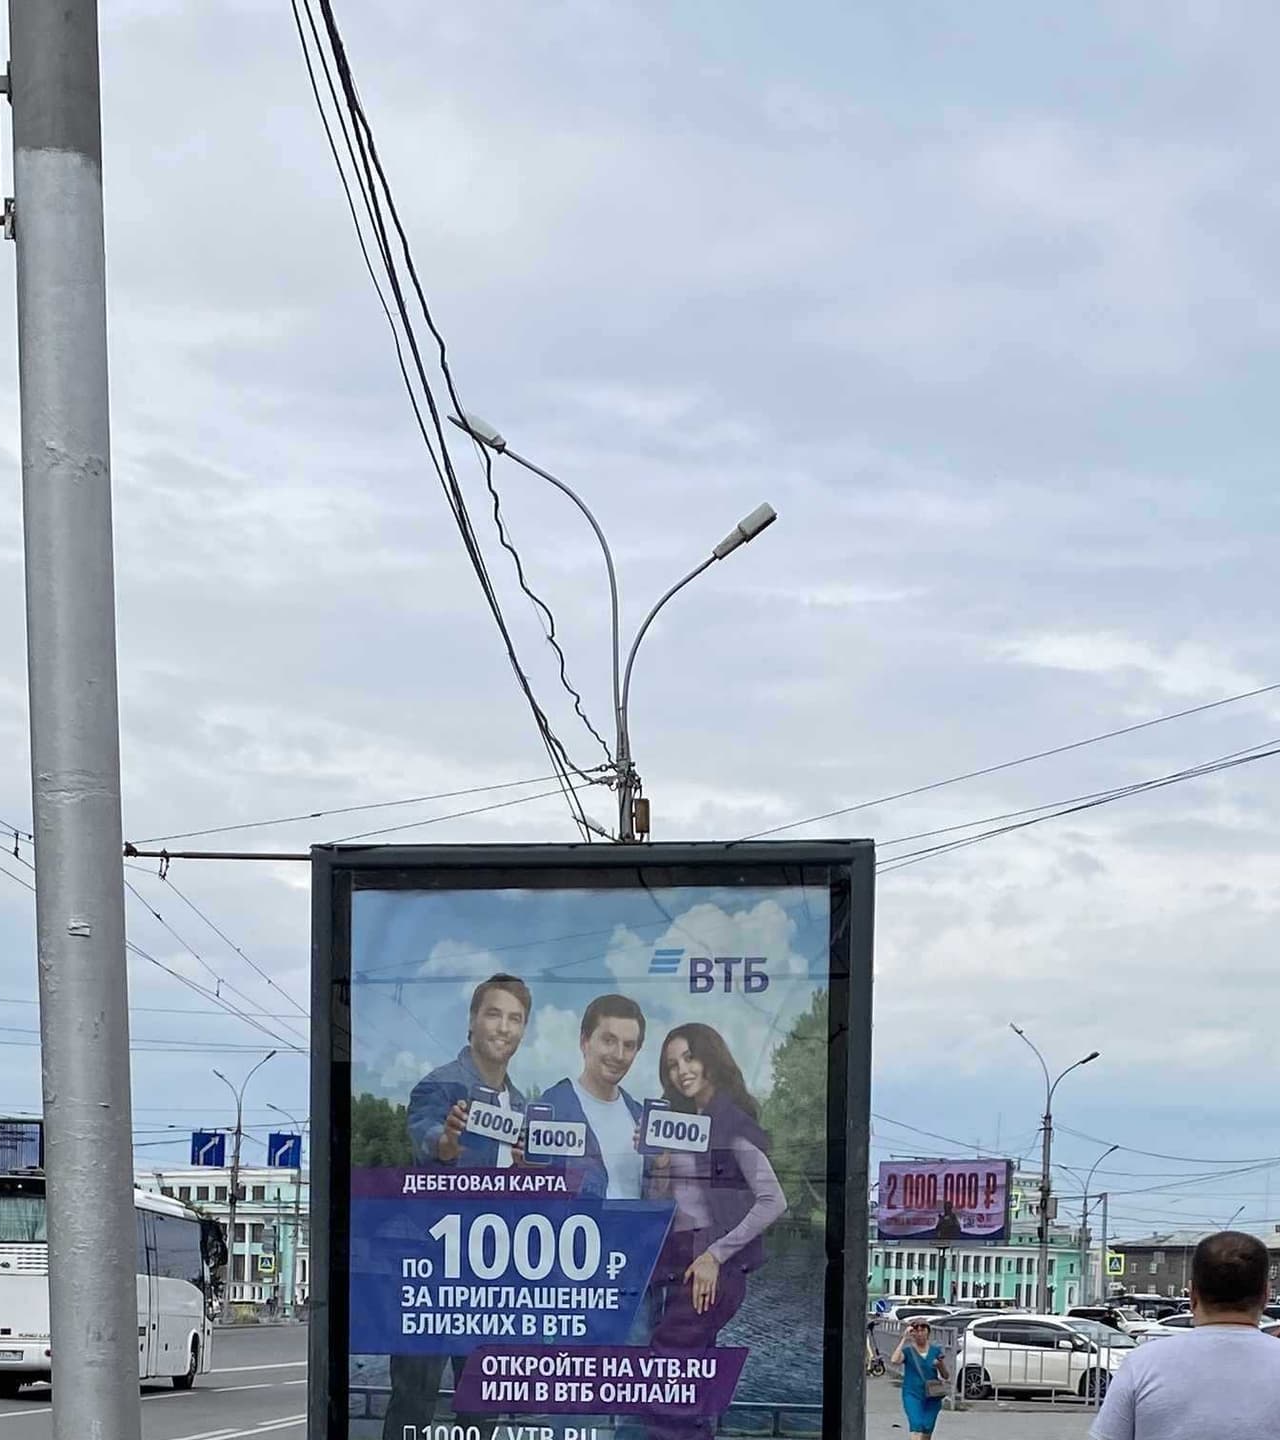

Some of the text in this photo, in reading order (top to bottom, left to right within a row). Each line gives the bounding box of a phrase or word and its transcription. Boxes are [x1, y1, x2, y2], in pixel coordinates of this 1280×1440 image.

[689, 957, 769, 994] ВТБ
[402, 1174, 567, 1193] ДЕБЕТОВАЯ КАРТА
[401, 1286, 619, 1309] ЗА ПРИГЛАШЕНИЕ
[402, 1312, 587, 1336] БЛИЗКИХ В ВТБ
[481, 1352, 717, 1378] ОТКРОЙТЕ НА VTB.RU
[481, 1380, 696, 1404] ИЛИ В ВТБ ОНЛАЙН
